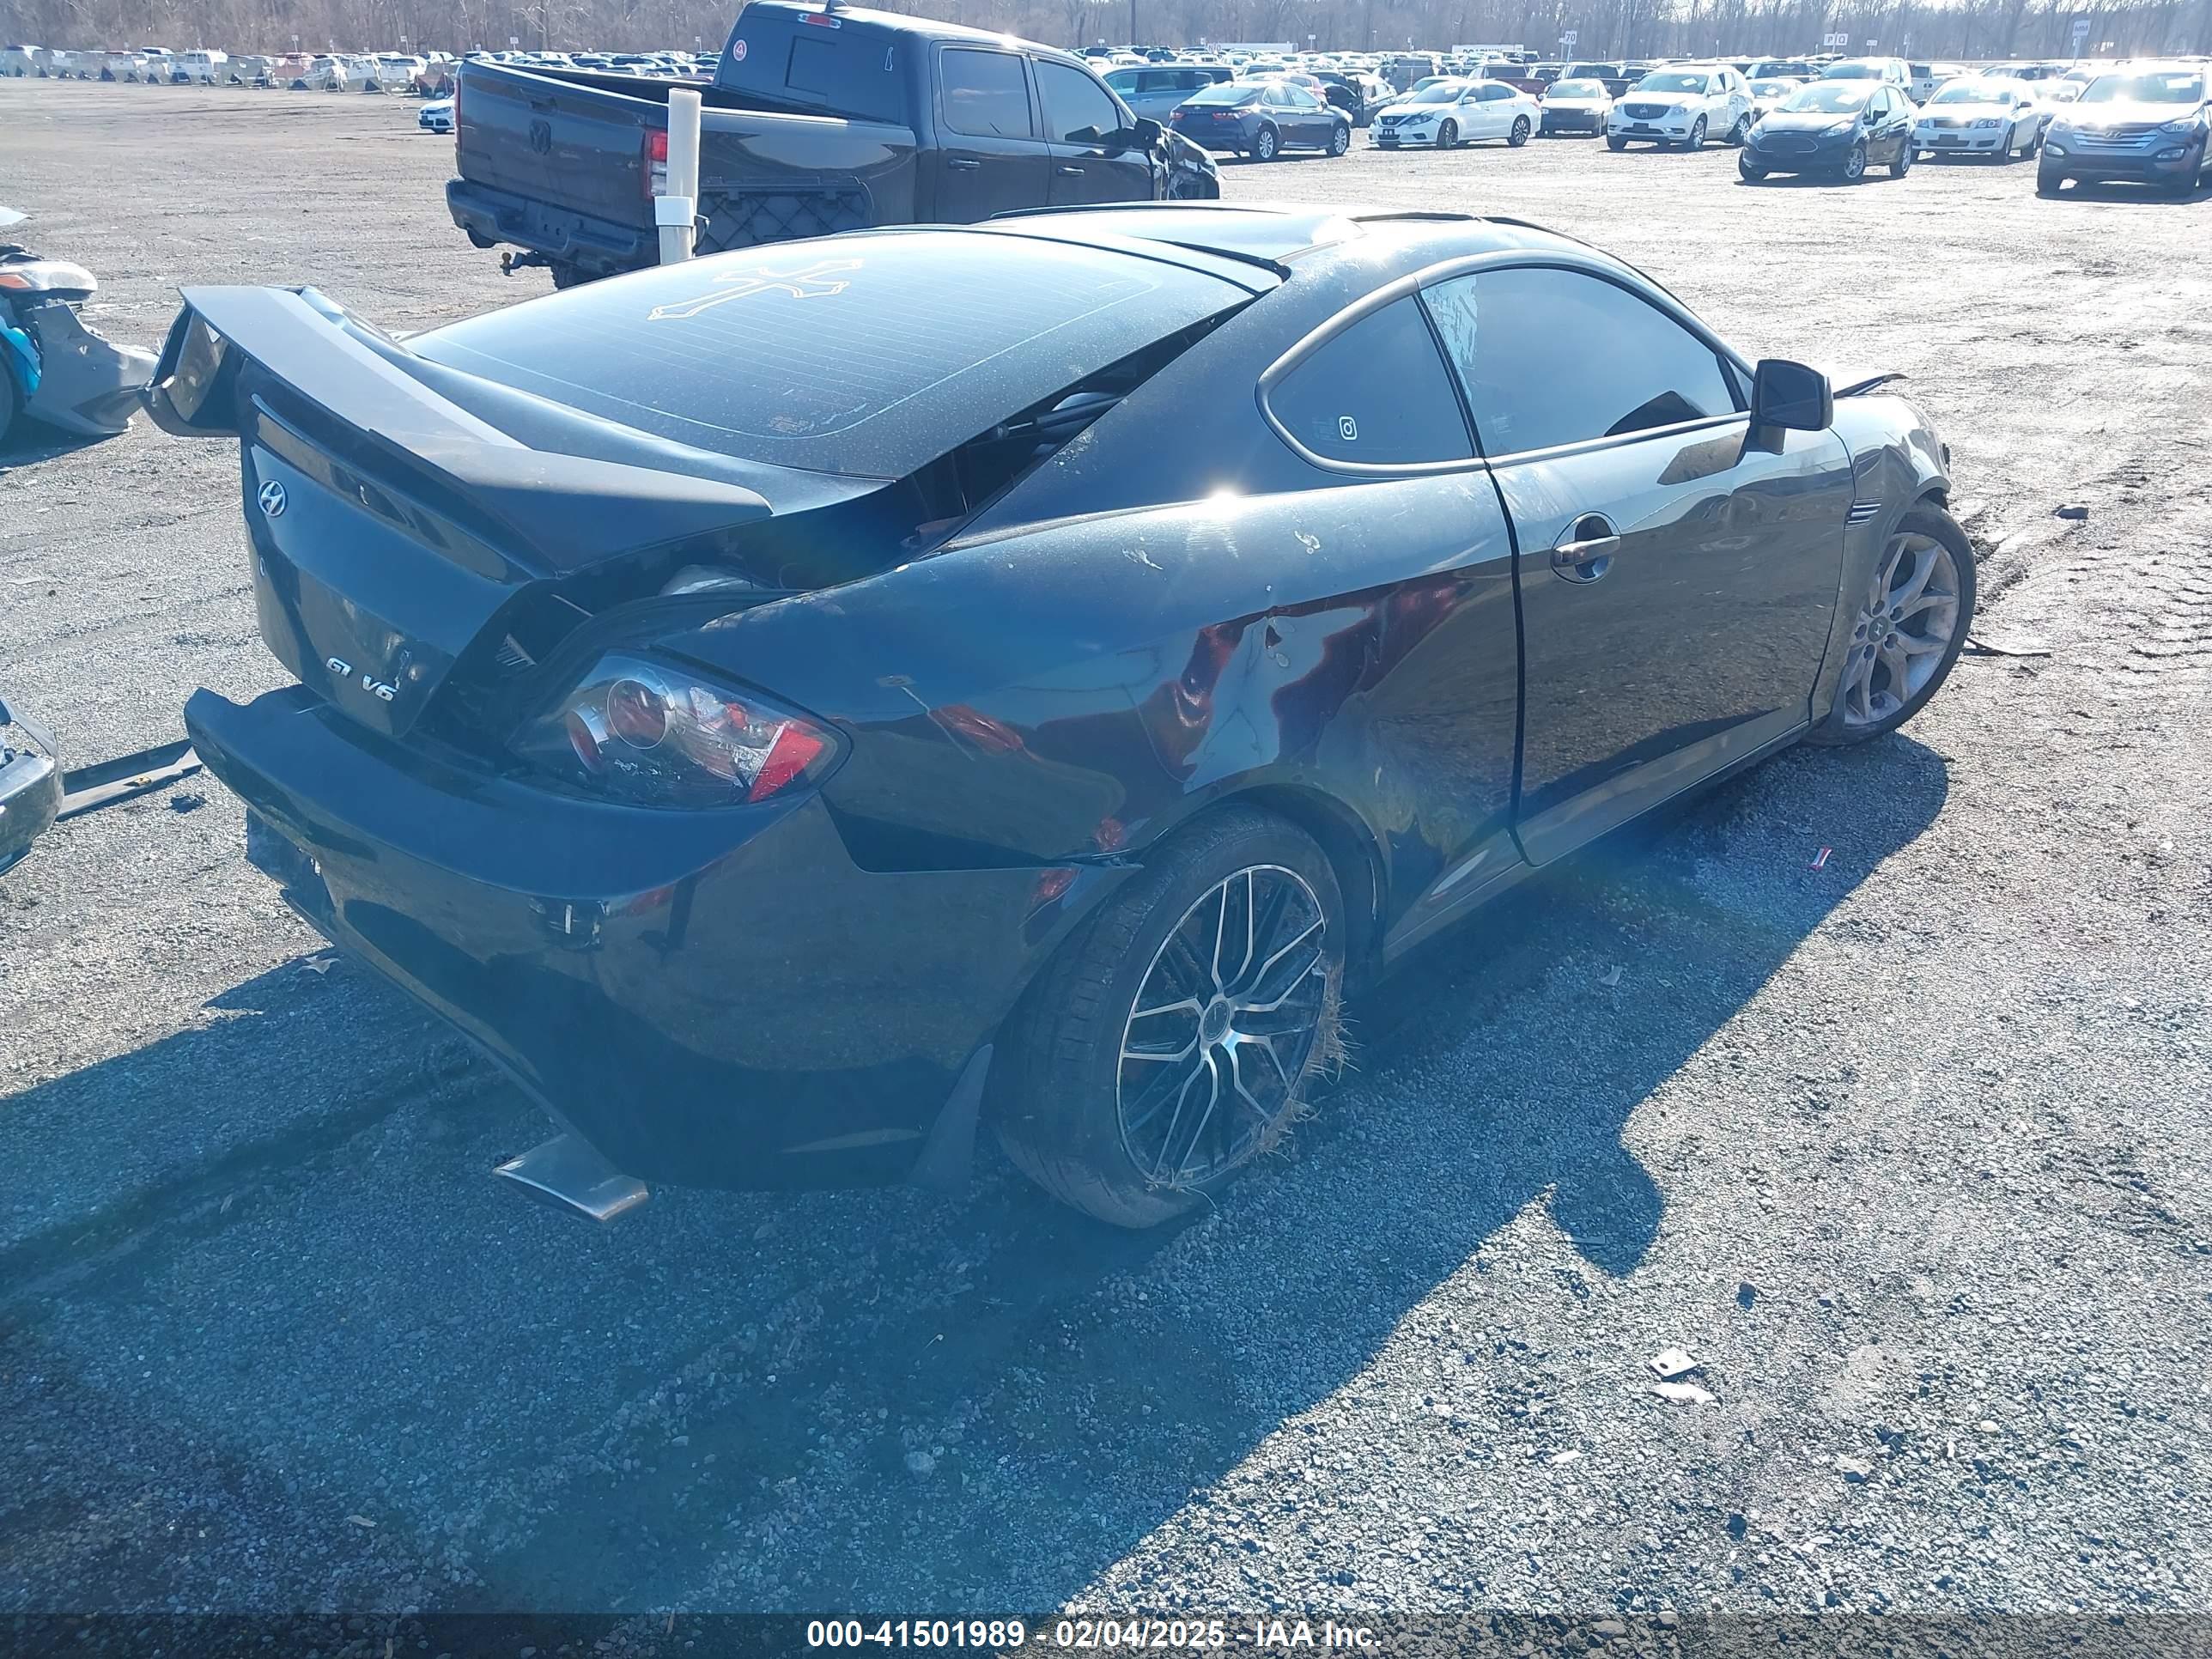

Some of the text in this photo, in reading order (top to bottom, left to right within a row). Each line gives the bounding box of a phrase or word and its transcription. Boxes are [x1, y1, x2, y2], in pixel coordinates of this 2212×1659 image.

[1565, 33, 1577, 42] 70
[326, 658, 398, 701] GT V6
